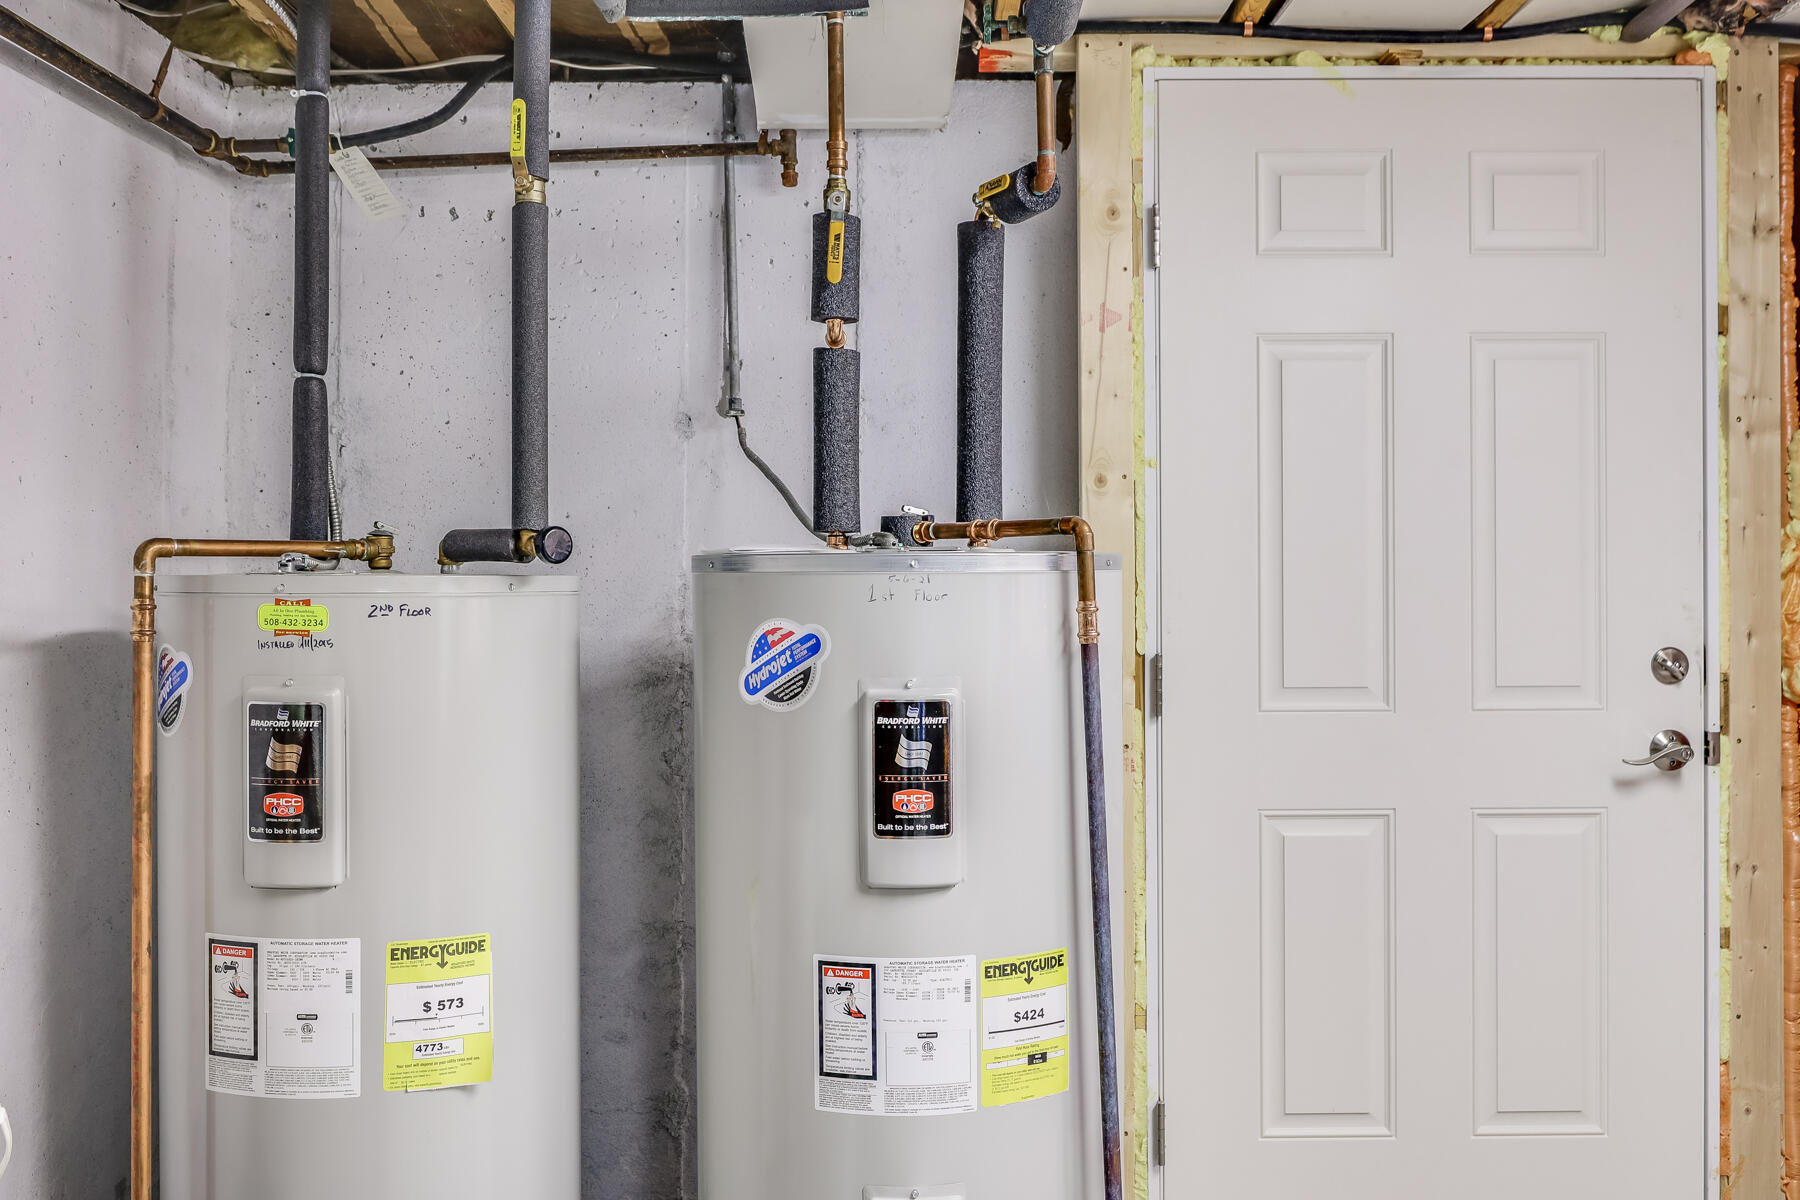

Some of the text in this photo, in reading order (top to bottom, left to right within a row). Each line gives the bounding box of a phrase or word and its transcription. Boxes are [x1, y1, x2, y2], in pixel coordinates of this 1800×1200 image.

[867, 583, 948, 602] 1st Floor
[368, 604, 393, 618] 2ND
[748, 649, 793, 690] Hydrojet
[250, 719, 320, 728] BRADFORD WHITE
[876, 716, 949, 725] BRADFORD WHITE
[266, 798, 302, 806] PHCC
[895, 794, 932, 802] PHCC
[222, 948, 247, 956] DANGER
[390, 939, 486, 965] ENERGYGUIDE
[984, 954, 1065, 981] ENERGYGUIDE
[437, 997, 464, 1011] 573
[1014, 1007, 1045, 1023] $424
[415, 1042, 443, 1053] 4773
